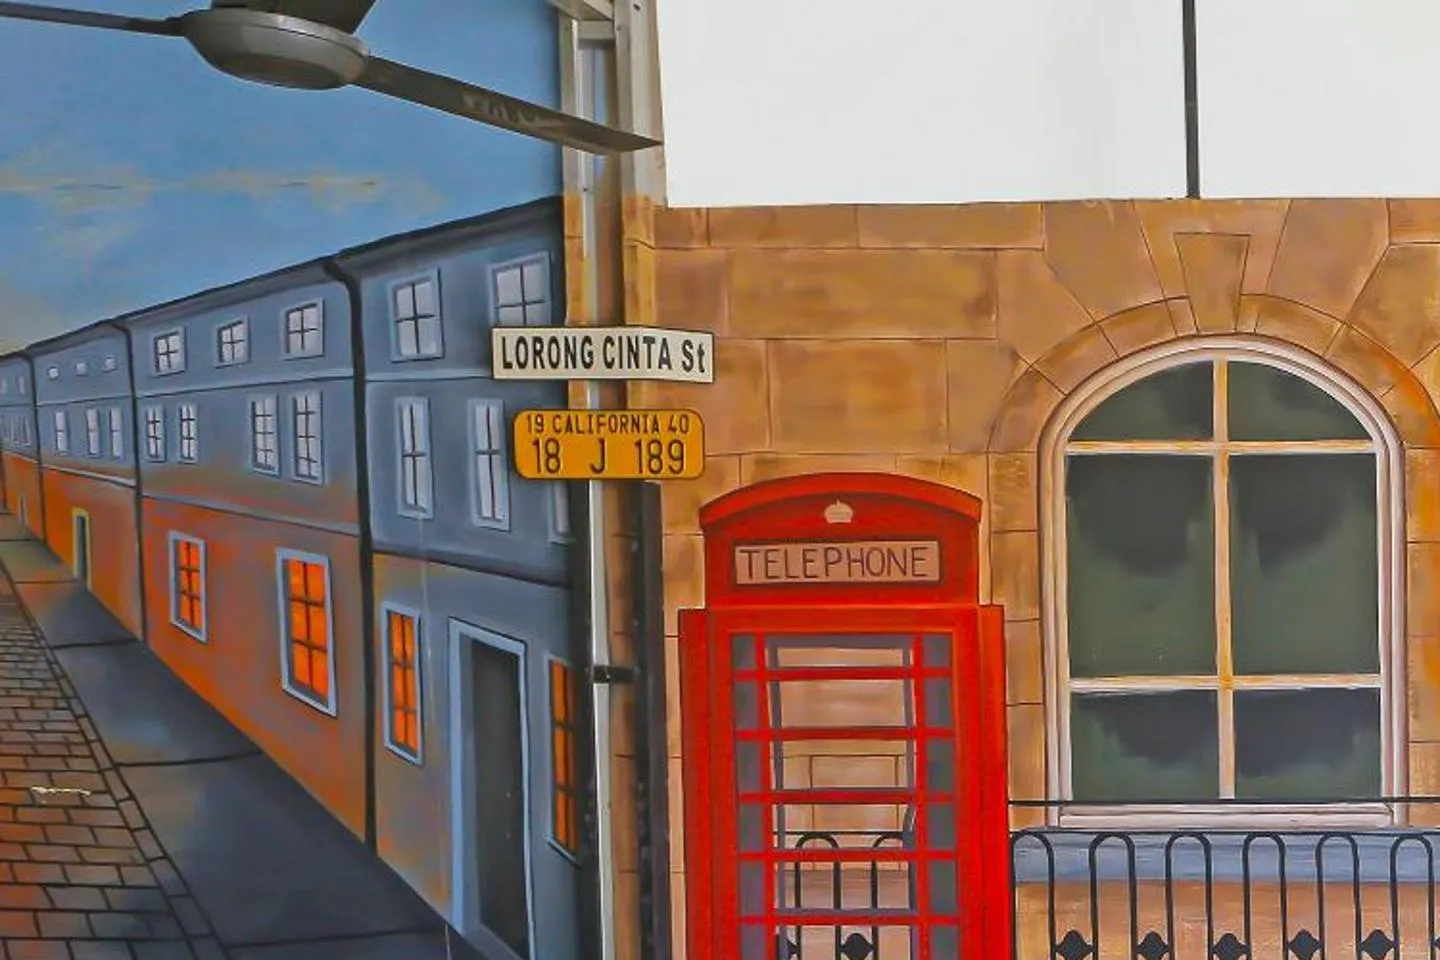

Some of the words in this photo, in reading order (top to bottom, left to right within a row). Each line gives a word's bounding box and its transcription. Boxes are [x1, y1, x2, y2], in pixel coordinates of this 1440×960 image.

[502, 335, 594, 370] LORONG
[603, 335, 672, 370] CINTA
[681, 339, 706, 373] St
[527, 413, 545, 434] 19
[552, 413, 660, 434] CALIFORNIA
[667, 413, 690, 434] 40
[532, 438, 561, 474] 18
[589, 438, 607, 474] J
[634, 438, 685, 475] 189
[739, 546, 930, 580] TELEPHONE
